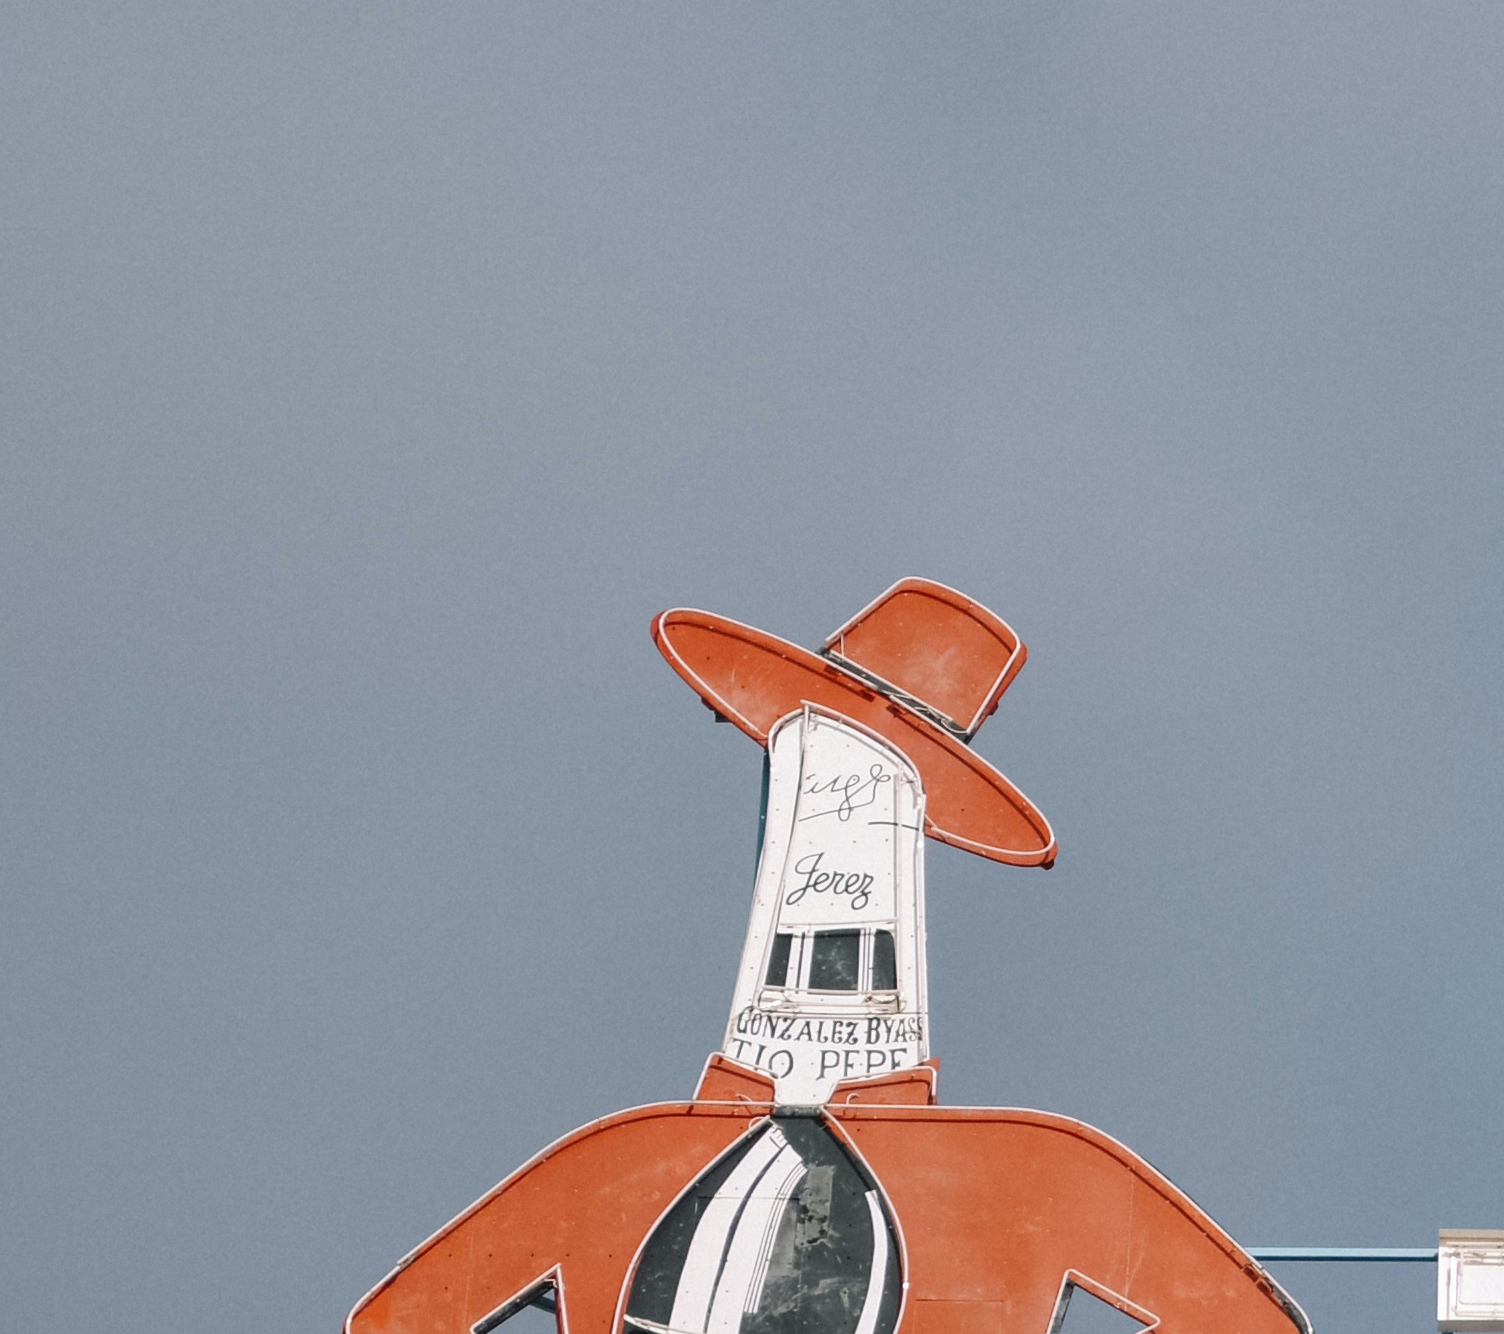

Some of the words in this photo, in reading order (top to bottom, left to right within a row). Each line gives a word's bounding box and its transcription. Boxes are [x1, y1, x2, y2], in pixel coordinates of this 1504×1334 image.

[786, 852, 873, 910] Jerez
[737, 1005, 858, 1045] GONZALEZ
[864, 1016, 923, 1046] BYASS
[732, 1038, 794, 1080] TIO
